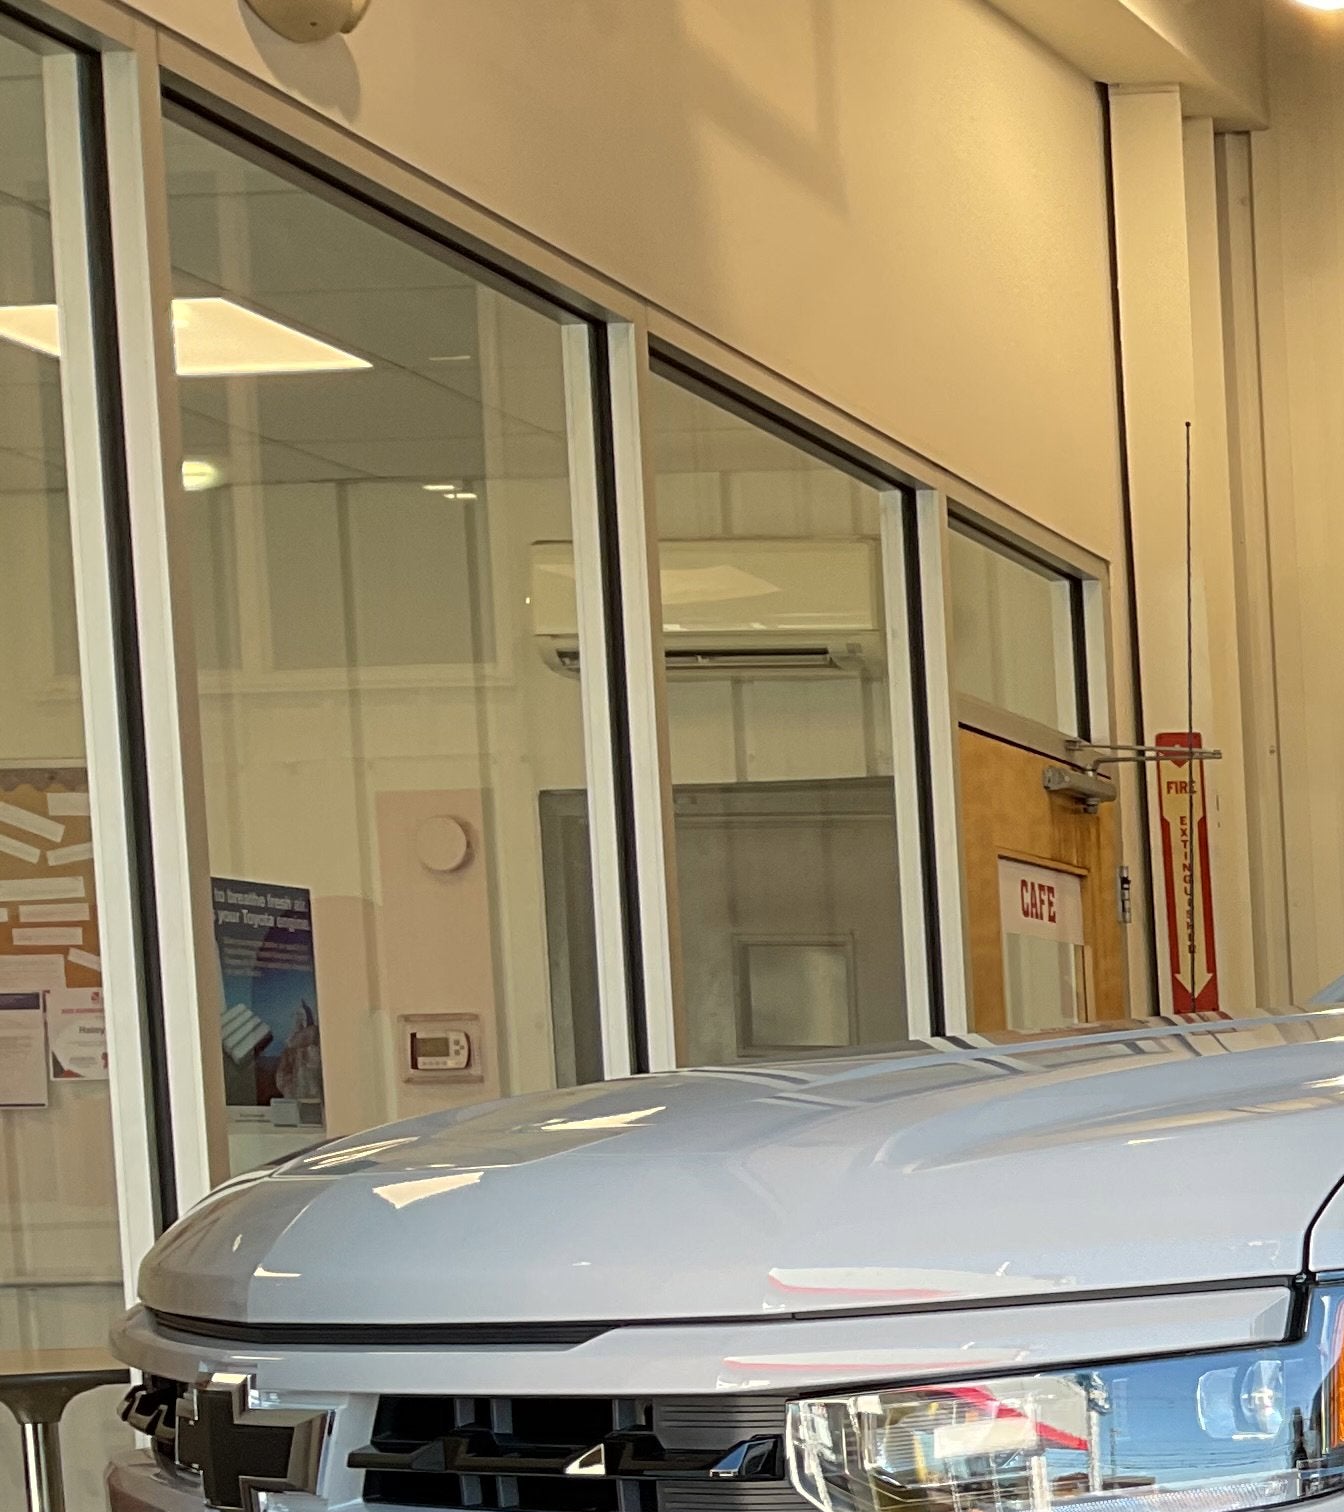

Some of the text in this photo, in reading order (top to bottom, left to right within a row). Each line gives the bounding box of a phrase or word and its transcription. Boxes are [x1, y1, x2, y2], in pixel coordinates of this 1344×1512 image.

[1166, 780, 1198, 795] FIRE
[226, 889, 266, 908] breathe
[1020, 879, 1057, 924] CAFE
[218, 909, 240, 925] your
[241, 909, 275, 928] Toyota
